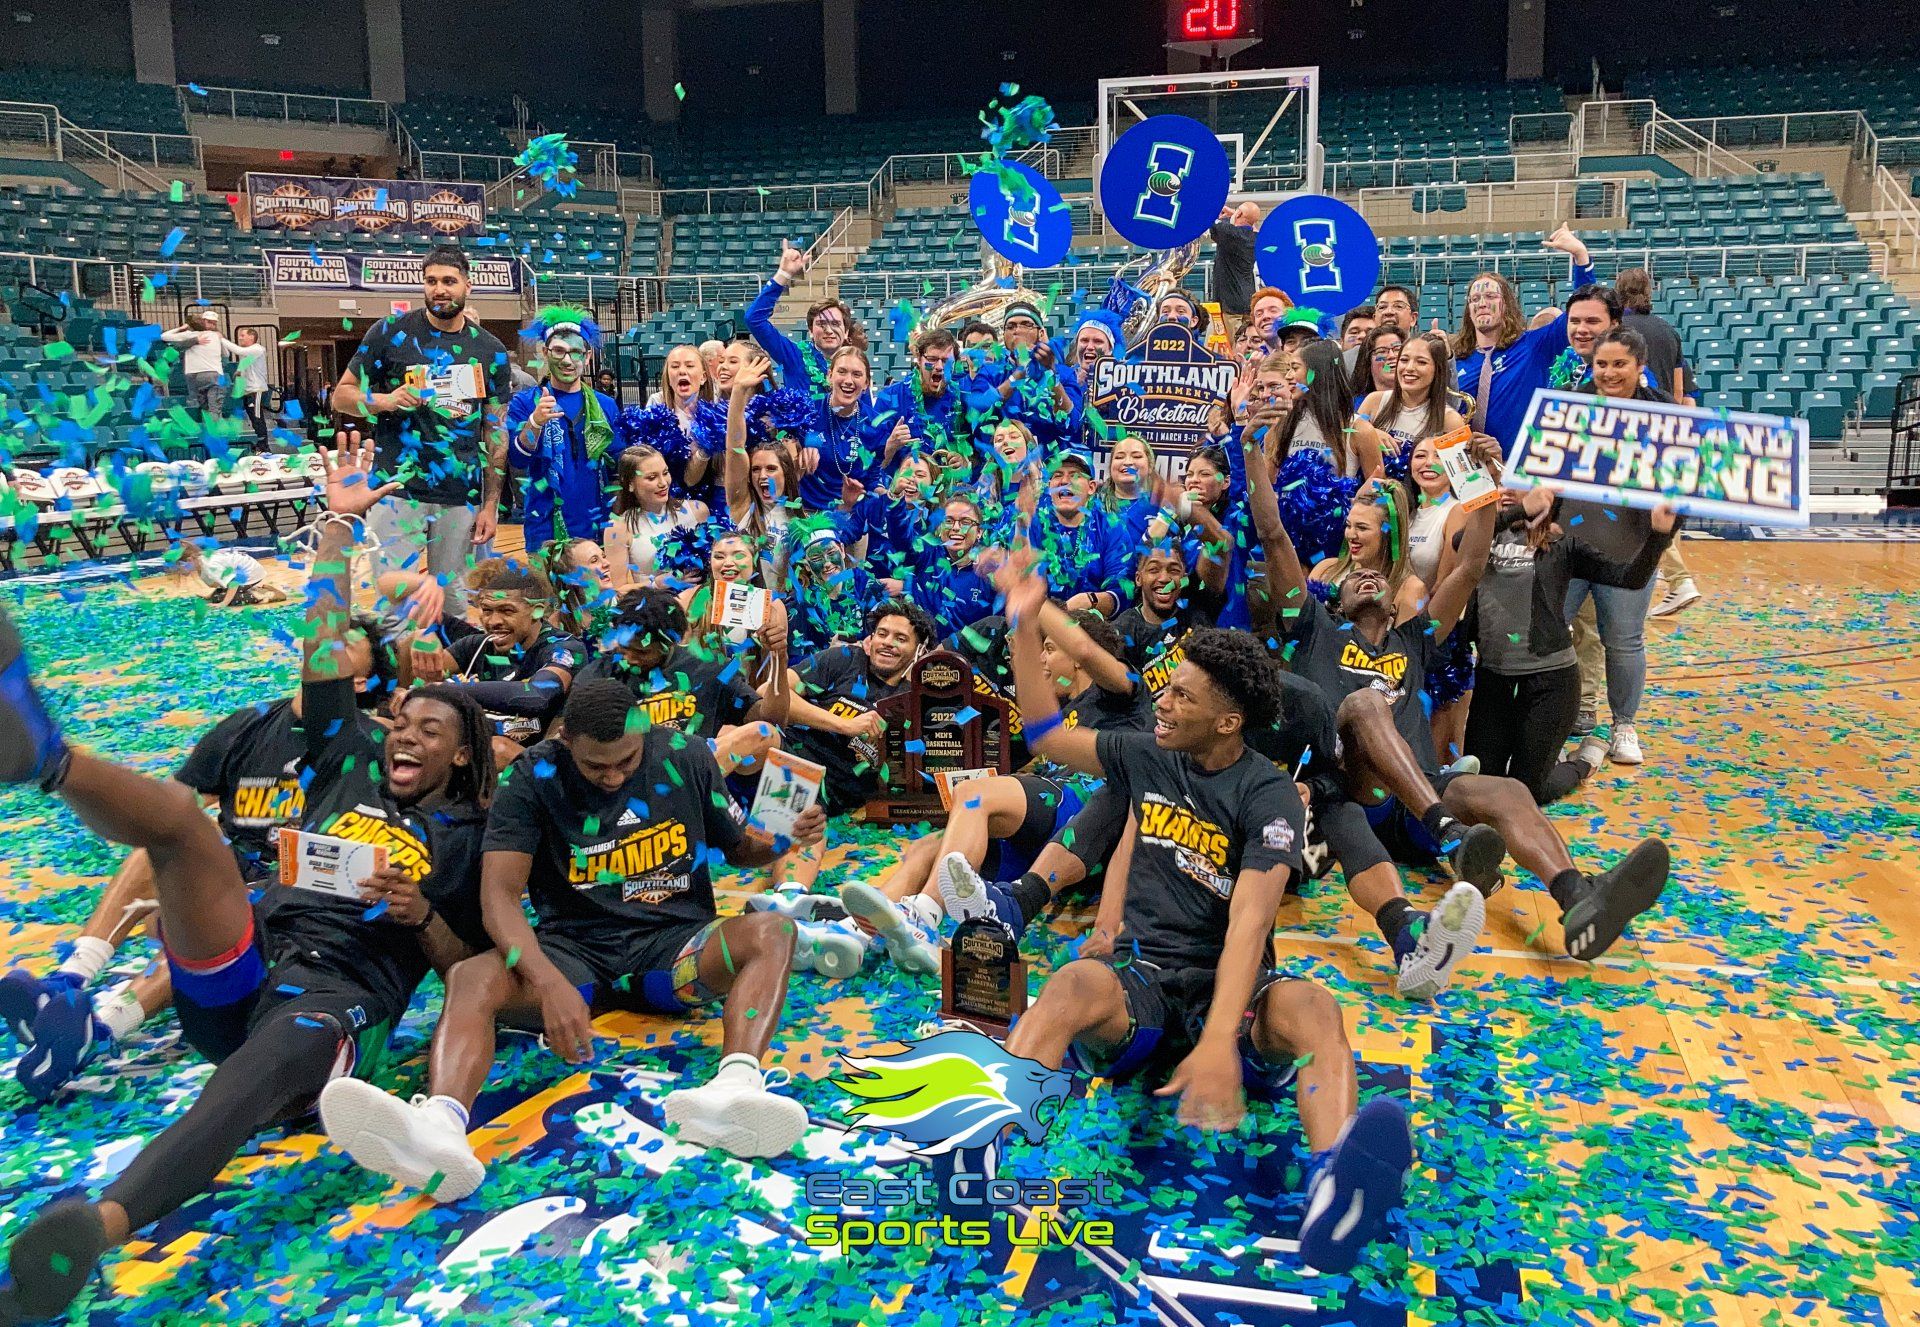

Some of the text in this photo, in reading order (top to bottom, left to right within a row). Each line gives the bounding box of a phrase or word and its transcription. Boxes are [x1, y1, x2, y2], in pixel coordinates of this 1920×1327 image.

[1187, 0, 1237, 32] 20
[255, 195, 329, 216] SOUTHLAND
[336, 199, 406, 218] SOUTHAND
[413, 201, 480, 222] SOUTHLAND
[366, 260, 423, 270] SOUTHLAN
[469, 263, 508, 272] THLAND
[277, 267, 346, 282] STRONG
[469, 271, 510, 286] RONG
[1152, 339, 1186, 351] 2022
[1097, 361, 1237, 398] SOUTHLAND
[1120, 385, 1211, 400] TORNAMENT
[1116, 396, 1212, 424] Basketball
[1146, 431, 1154, 440] TX
[1161, 431, 1182, 441] MARCH
[1183, 433, 1198, 442] 9-13
[1539, 400, 1793, 460] SOUTHLAND
[1291, 440, 1326, 449] ISLANDE
[1522, 429, 1793, 508] STRONG
[930, 712, 956, 722] 2022
[934, 731, 953, 739] MEN'S
[925, 740, 962, 748] BASKETBALL
[925, 749, 964, 757] TOURNAMENT
[568, 823, 688, 883] CHAMPS
[623, 873, 690, 897] SOUTHLAND
[963, 938, 1003, 956] SOUTHLAND
